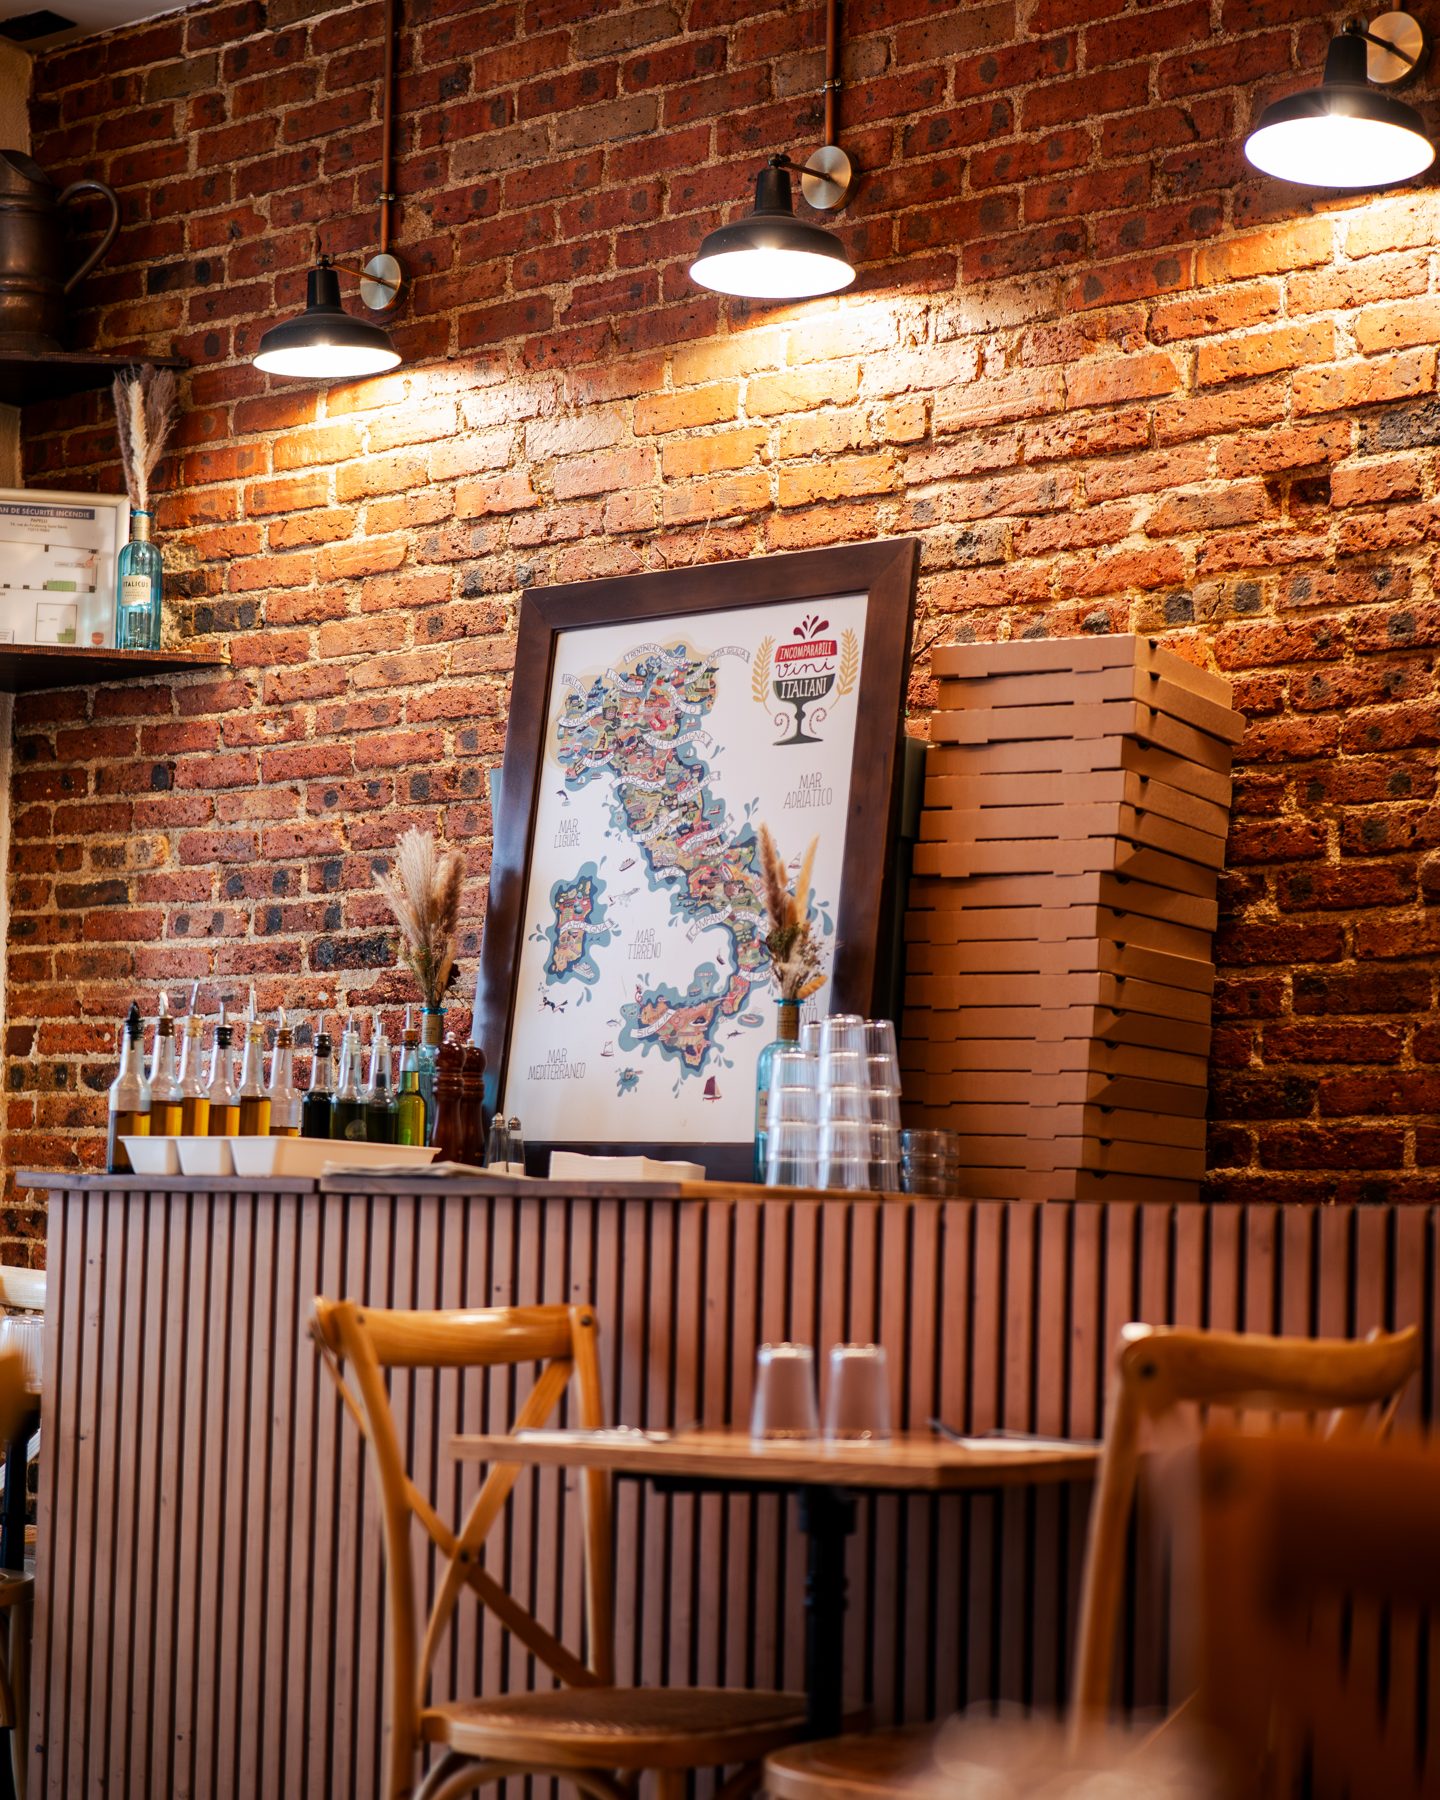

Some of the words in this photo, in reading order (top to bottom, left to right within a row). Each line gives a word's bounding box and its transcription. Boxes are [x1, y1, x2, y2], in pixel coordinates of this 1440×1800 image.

[10, 506, 20, 514] DE
[56, 509, 90, 519] INCENDIE
[123, 581, 149, 589] ITALICUS
[779, 641, 832, 660] INCOMPARABILI
[776, 657, 835, 678] vini
[780, 677, 827, 699] ITALIANI
[620, 776, 661, 788] TOSCANA
[798, 771, 822, 789] MAR
[783, 787, 833, 809] ADRIATICO
[558, 817, 579, 834] MAR
[554, 832, 581, 849] LIGURE
[634, 928, 656, 943] MAR
[628, 942, 662, 960] TIRRENO
[637, 1012, 672, 1036] SICILIA
[547, 1047, 568, 1063] MAR
[527, 1062, 586, 1080] MEDITERRANEO
